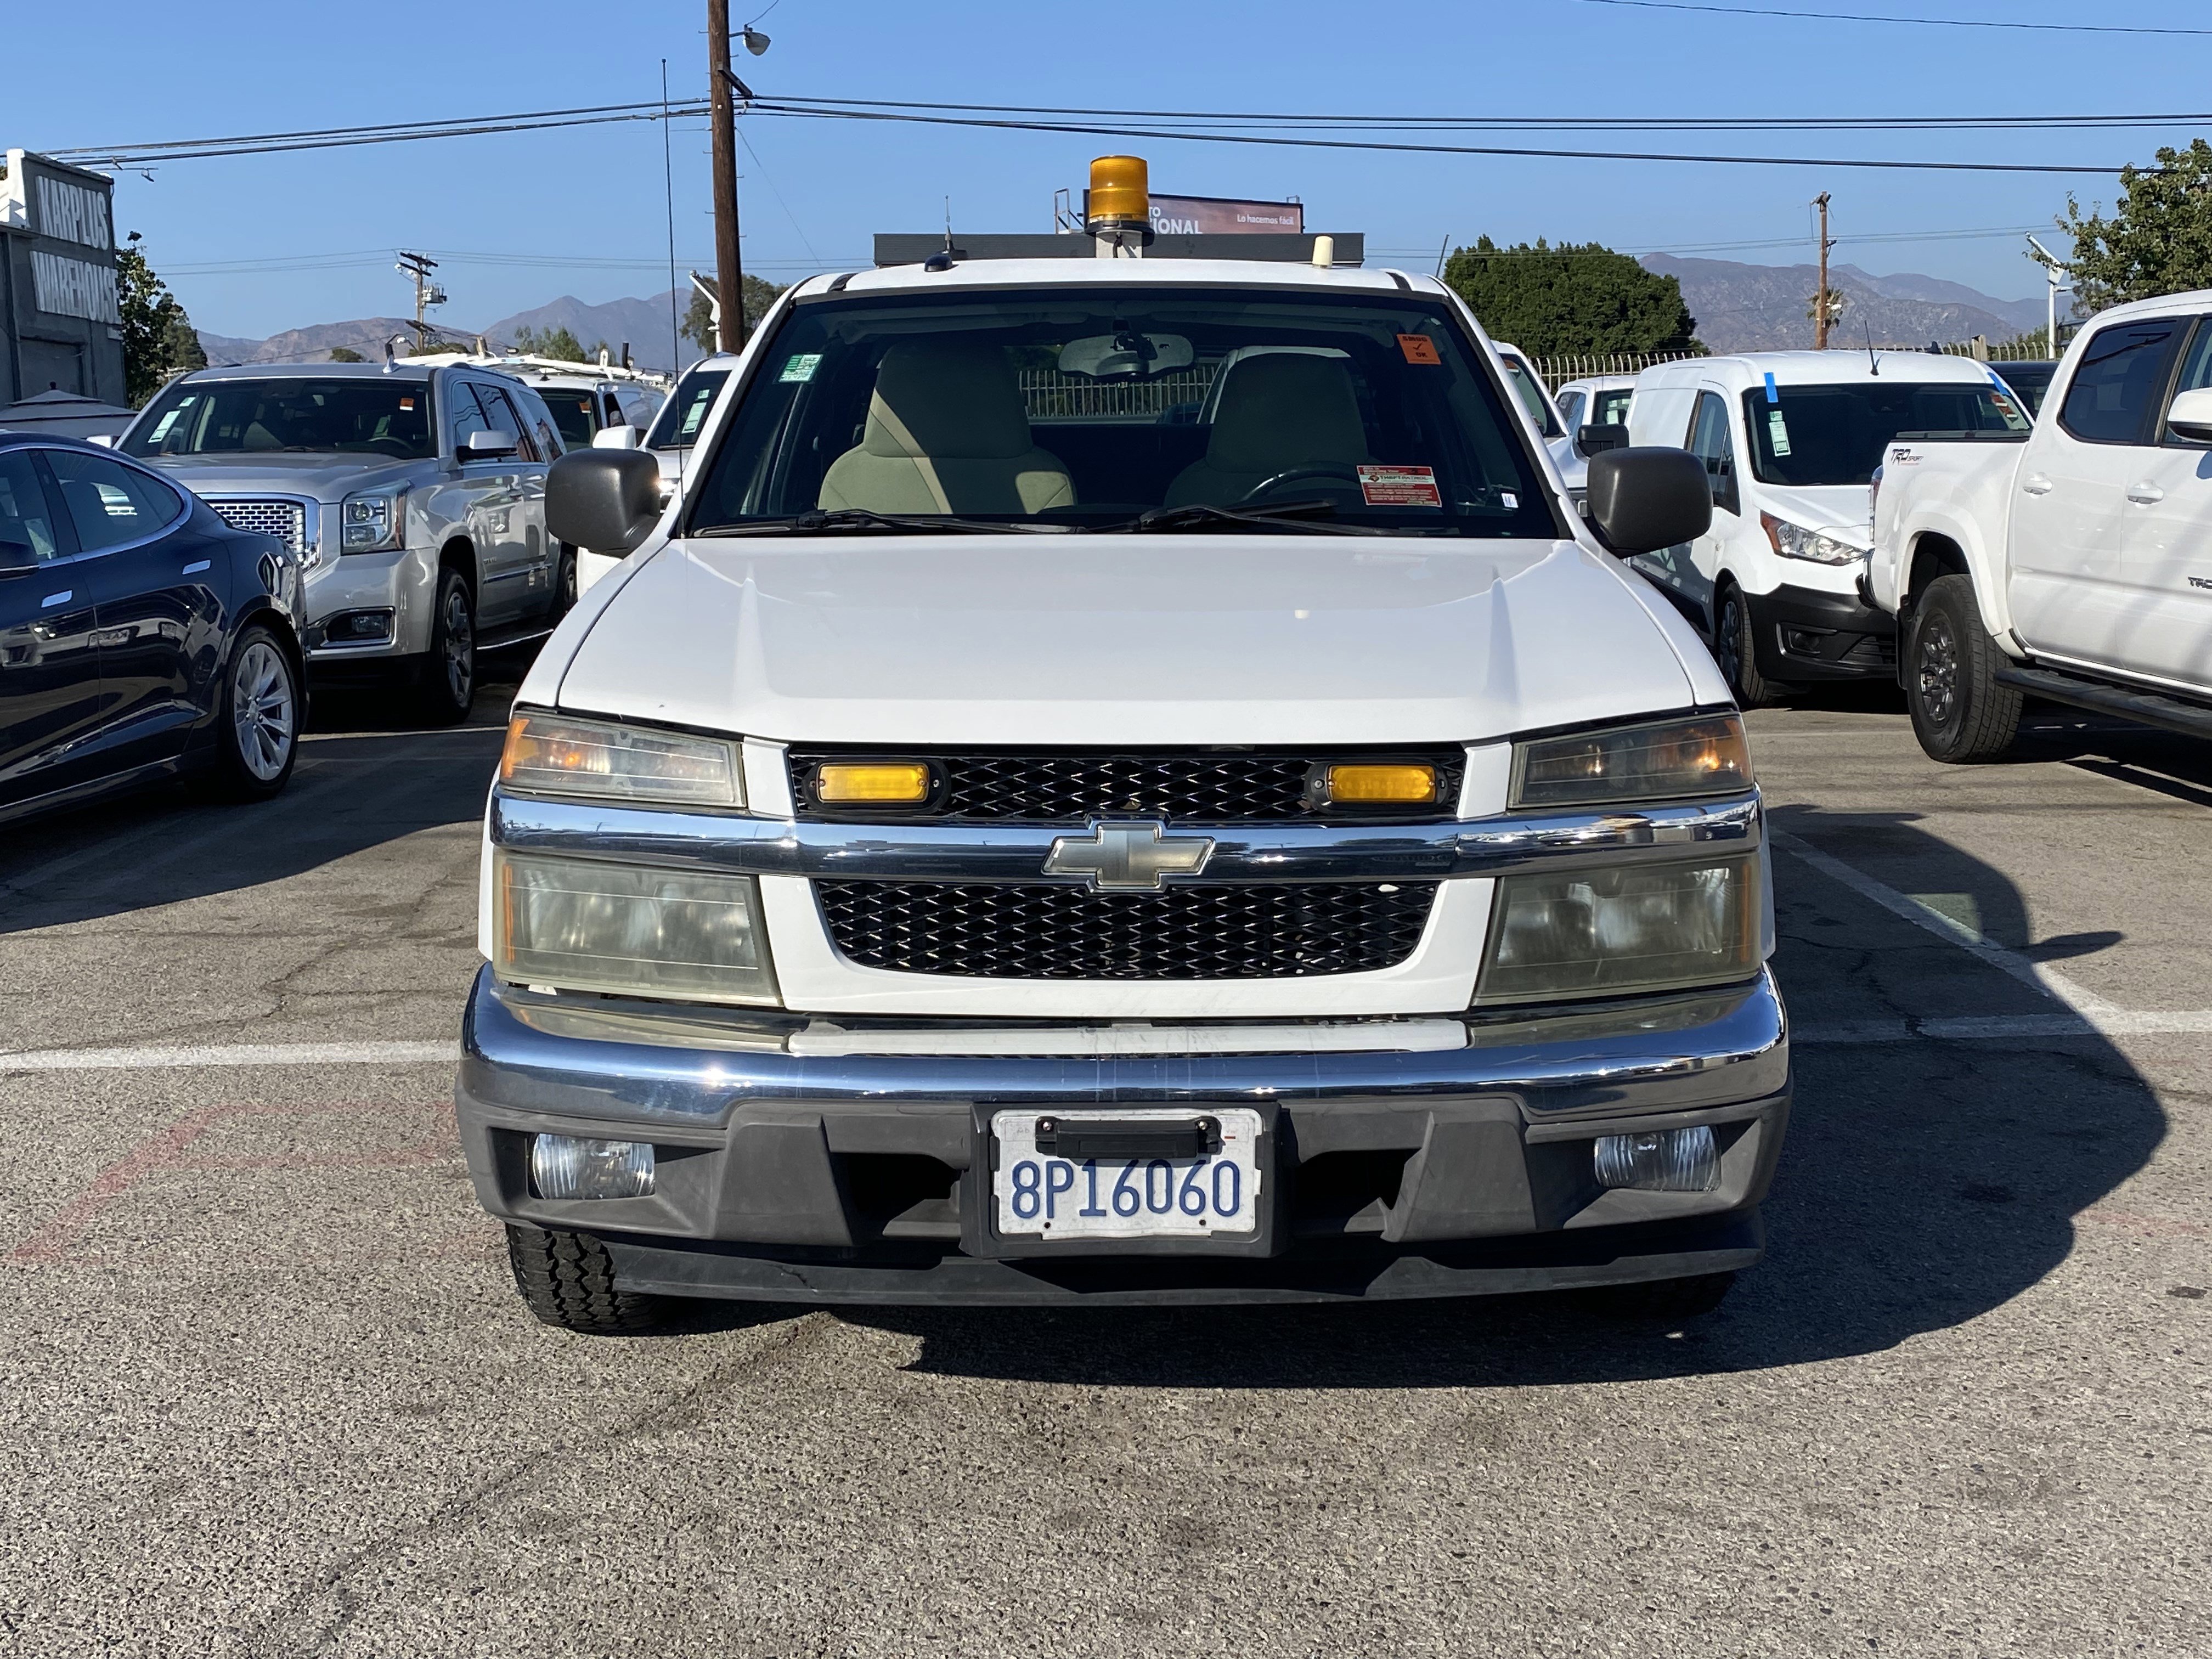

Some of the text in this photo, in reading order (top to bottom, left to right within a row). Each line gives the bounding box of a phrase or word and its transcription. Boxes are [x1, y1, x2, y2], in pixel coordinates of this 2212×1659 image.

[35, 176, 109, 250] KARPLUS
[1149, 218, 1203, 234] IONAL
[1237, 213, 1246, 223] Lo
[1247, 213, 1278, 224] hacemos
[30, 250, 122, 325] WAREHOUSE
[1891, 449, 1911, 465] TRD
[1012, 1158, 1241, 1219] 8P16060
